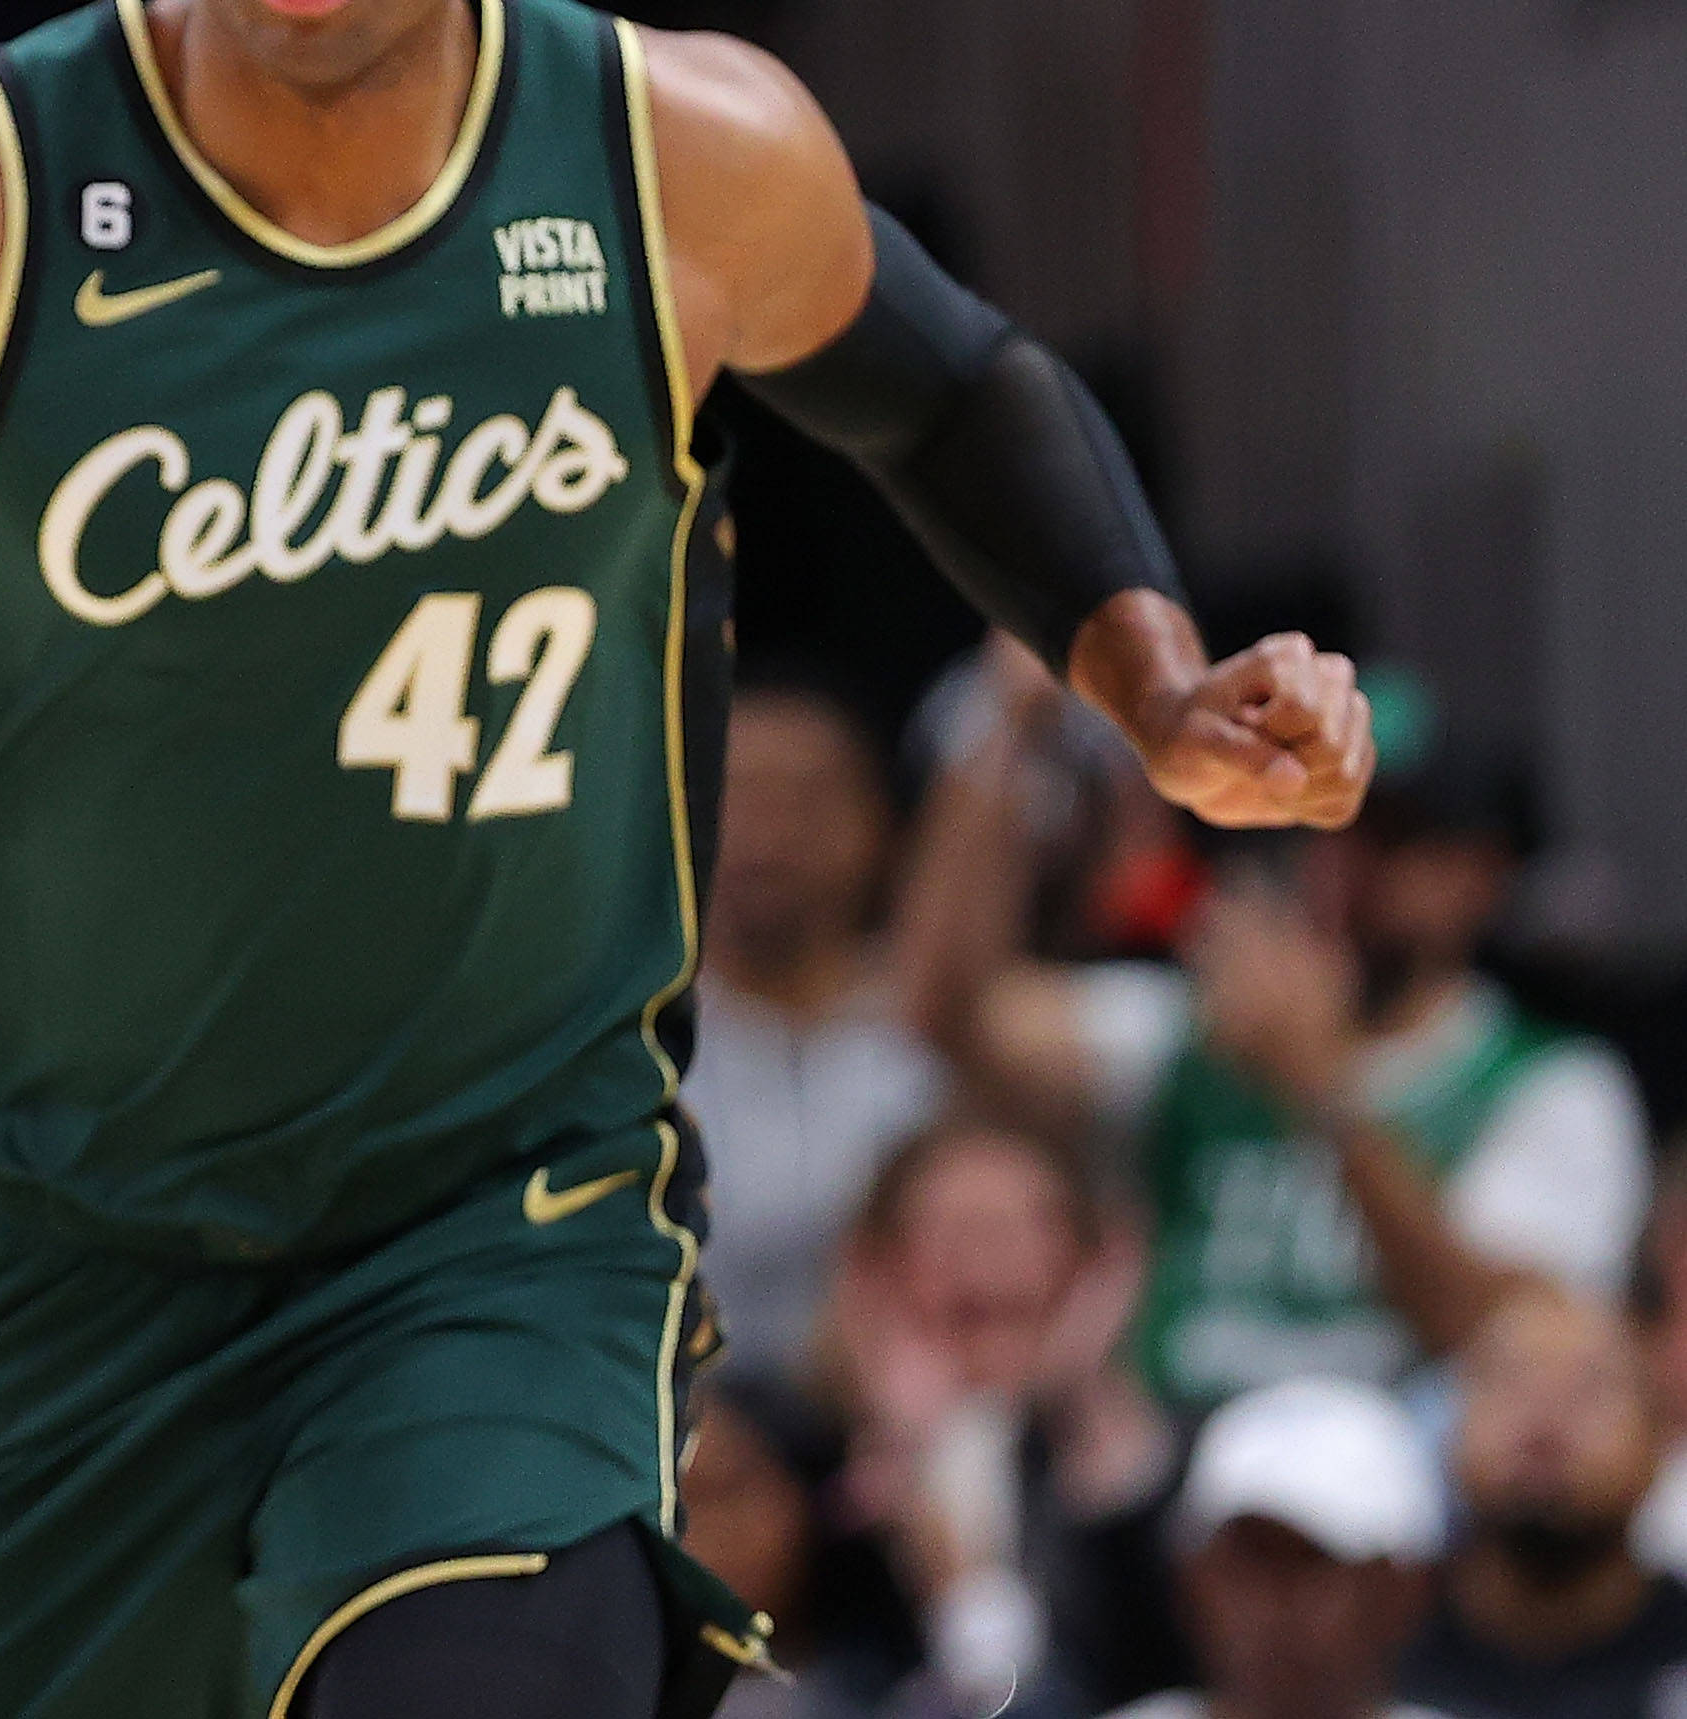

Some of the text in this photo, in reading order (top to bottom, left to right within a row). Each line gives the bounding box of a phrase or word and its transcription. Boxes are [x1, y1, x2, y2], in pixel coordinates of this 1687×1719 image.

[81, 182, 133, 250] 6
[492, 216, 607, 272] VISTA
[498, 271, 610, 318] PRINT
[38, 386, 628, 627] Celtics
[337, 585, 599, 825] 42
